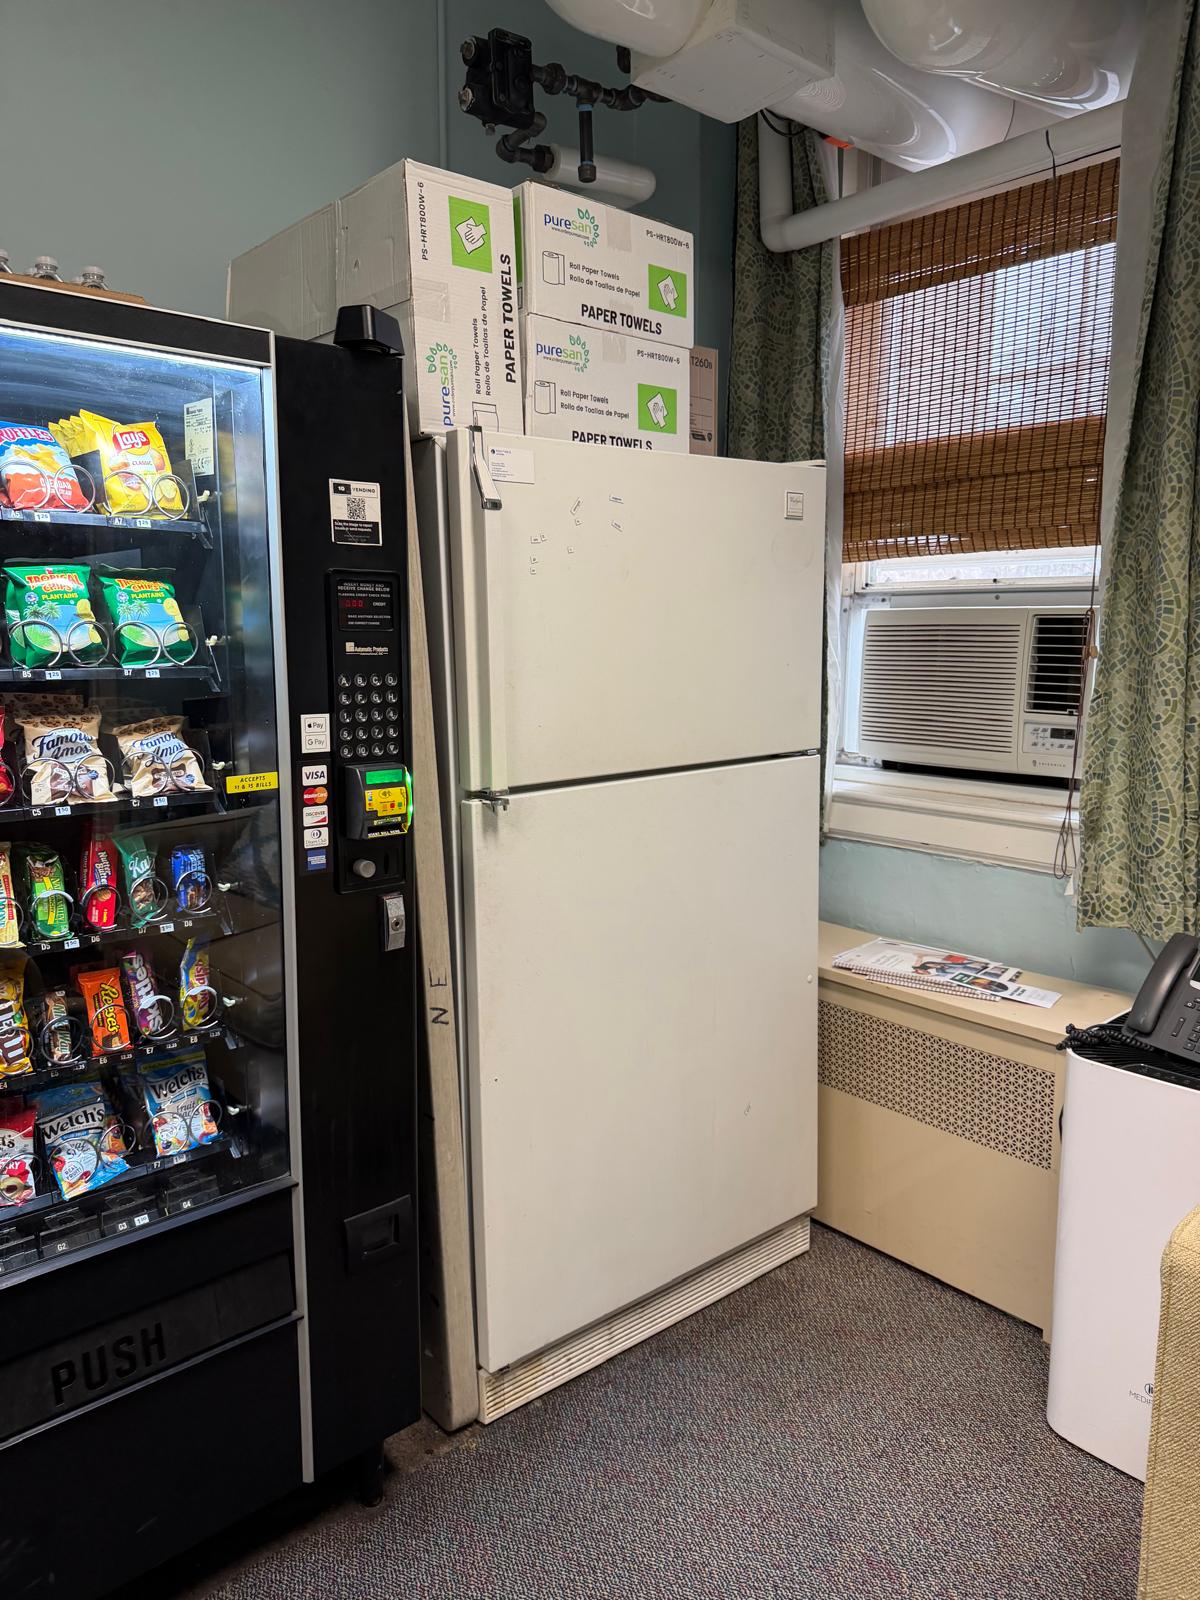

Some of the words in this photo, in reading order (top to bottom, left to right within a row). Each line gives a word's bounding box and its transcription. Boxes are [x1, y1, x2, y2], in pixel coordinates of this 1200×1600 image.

[417, 181, 429, 261] PS-HRT800W-6
[544, 213, 592, 234] puresan
[646, 229, 690, 249] PS-HRT800W-6
[569, 262, 581, 271] Roll
[581, 265, 599, 277] Paper
[600, 269, 620, 281] Towels
[500, 253, 514, 324] TOWELS
[569, 274, 585, 284] Rollo
[585, 278, 594, 286] de
[594, 280, 615, 292] Toallas
[616, 285, 624, 294] de
[624, 288, 641, 298] Papel
[480, 286, 489, 311] Papel
[482, 313, 488, 326] de
[581, 303, 617, 325] PAPER
[619, 312, 662, 335] TOWELS
[503, 329, 516, 383] PAPER
[536, 343, 582, 361] puresan
[637, 349, 681, 365] PS-HRT800W-6
[484, 361, 490, 373] de
[439, 355, 454, 427] puresan
[560, 389, 571, 397] Roll
[572, 392, 589, 402] Paper
[590, 396, 609, 404] Towels
[560, 402, 575, 411] Rollo
[575, 404, 584, 412] de
[585, 407, 605, 416] Toallas
[614, 411, 630, 420] Papel
[572, 431, 607, 446] PAPER
[41, 593, 79, 601] PLANTAINS
[32, 732, 94, 760] Famous
[315, 738, 325, 747] Pay
[51, 744, 92, 760] Amos
[304, 770, 326, 780] VISA
[98, 851, 112, 877] Nutter
[146, 1047, 154, 1055] E7
[0, 1082, 8, 1090] E4
[150, 1065, 206, 1099] Welch's
[43, 1107, 105, 1140] Welch's
[64, 1164, 78, 1176] REAL
[182, 1201, 192, 1209] G4
[118, 1222, 127, 1230] G3
[57, 1242, 66, 1251] G2
[51, 1321, 168, 1407] PUSH
